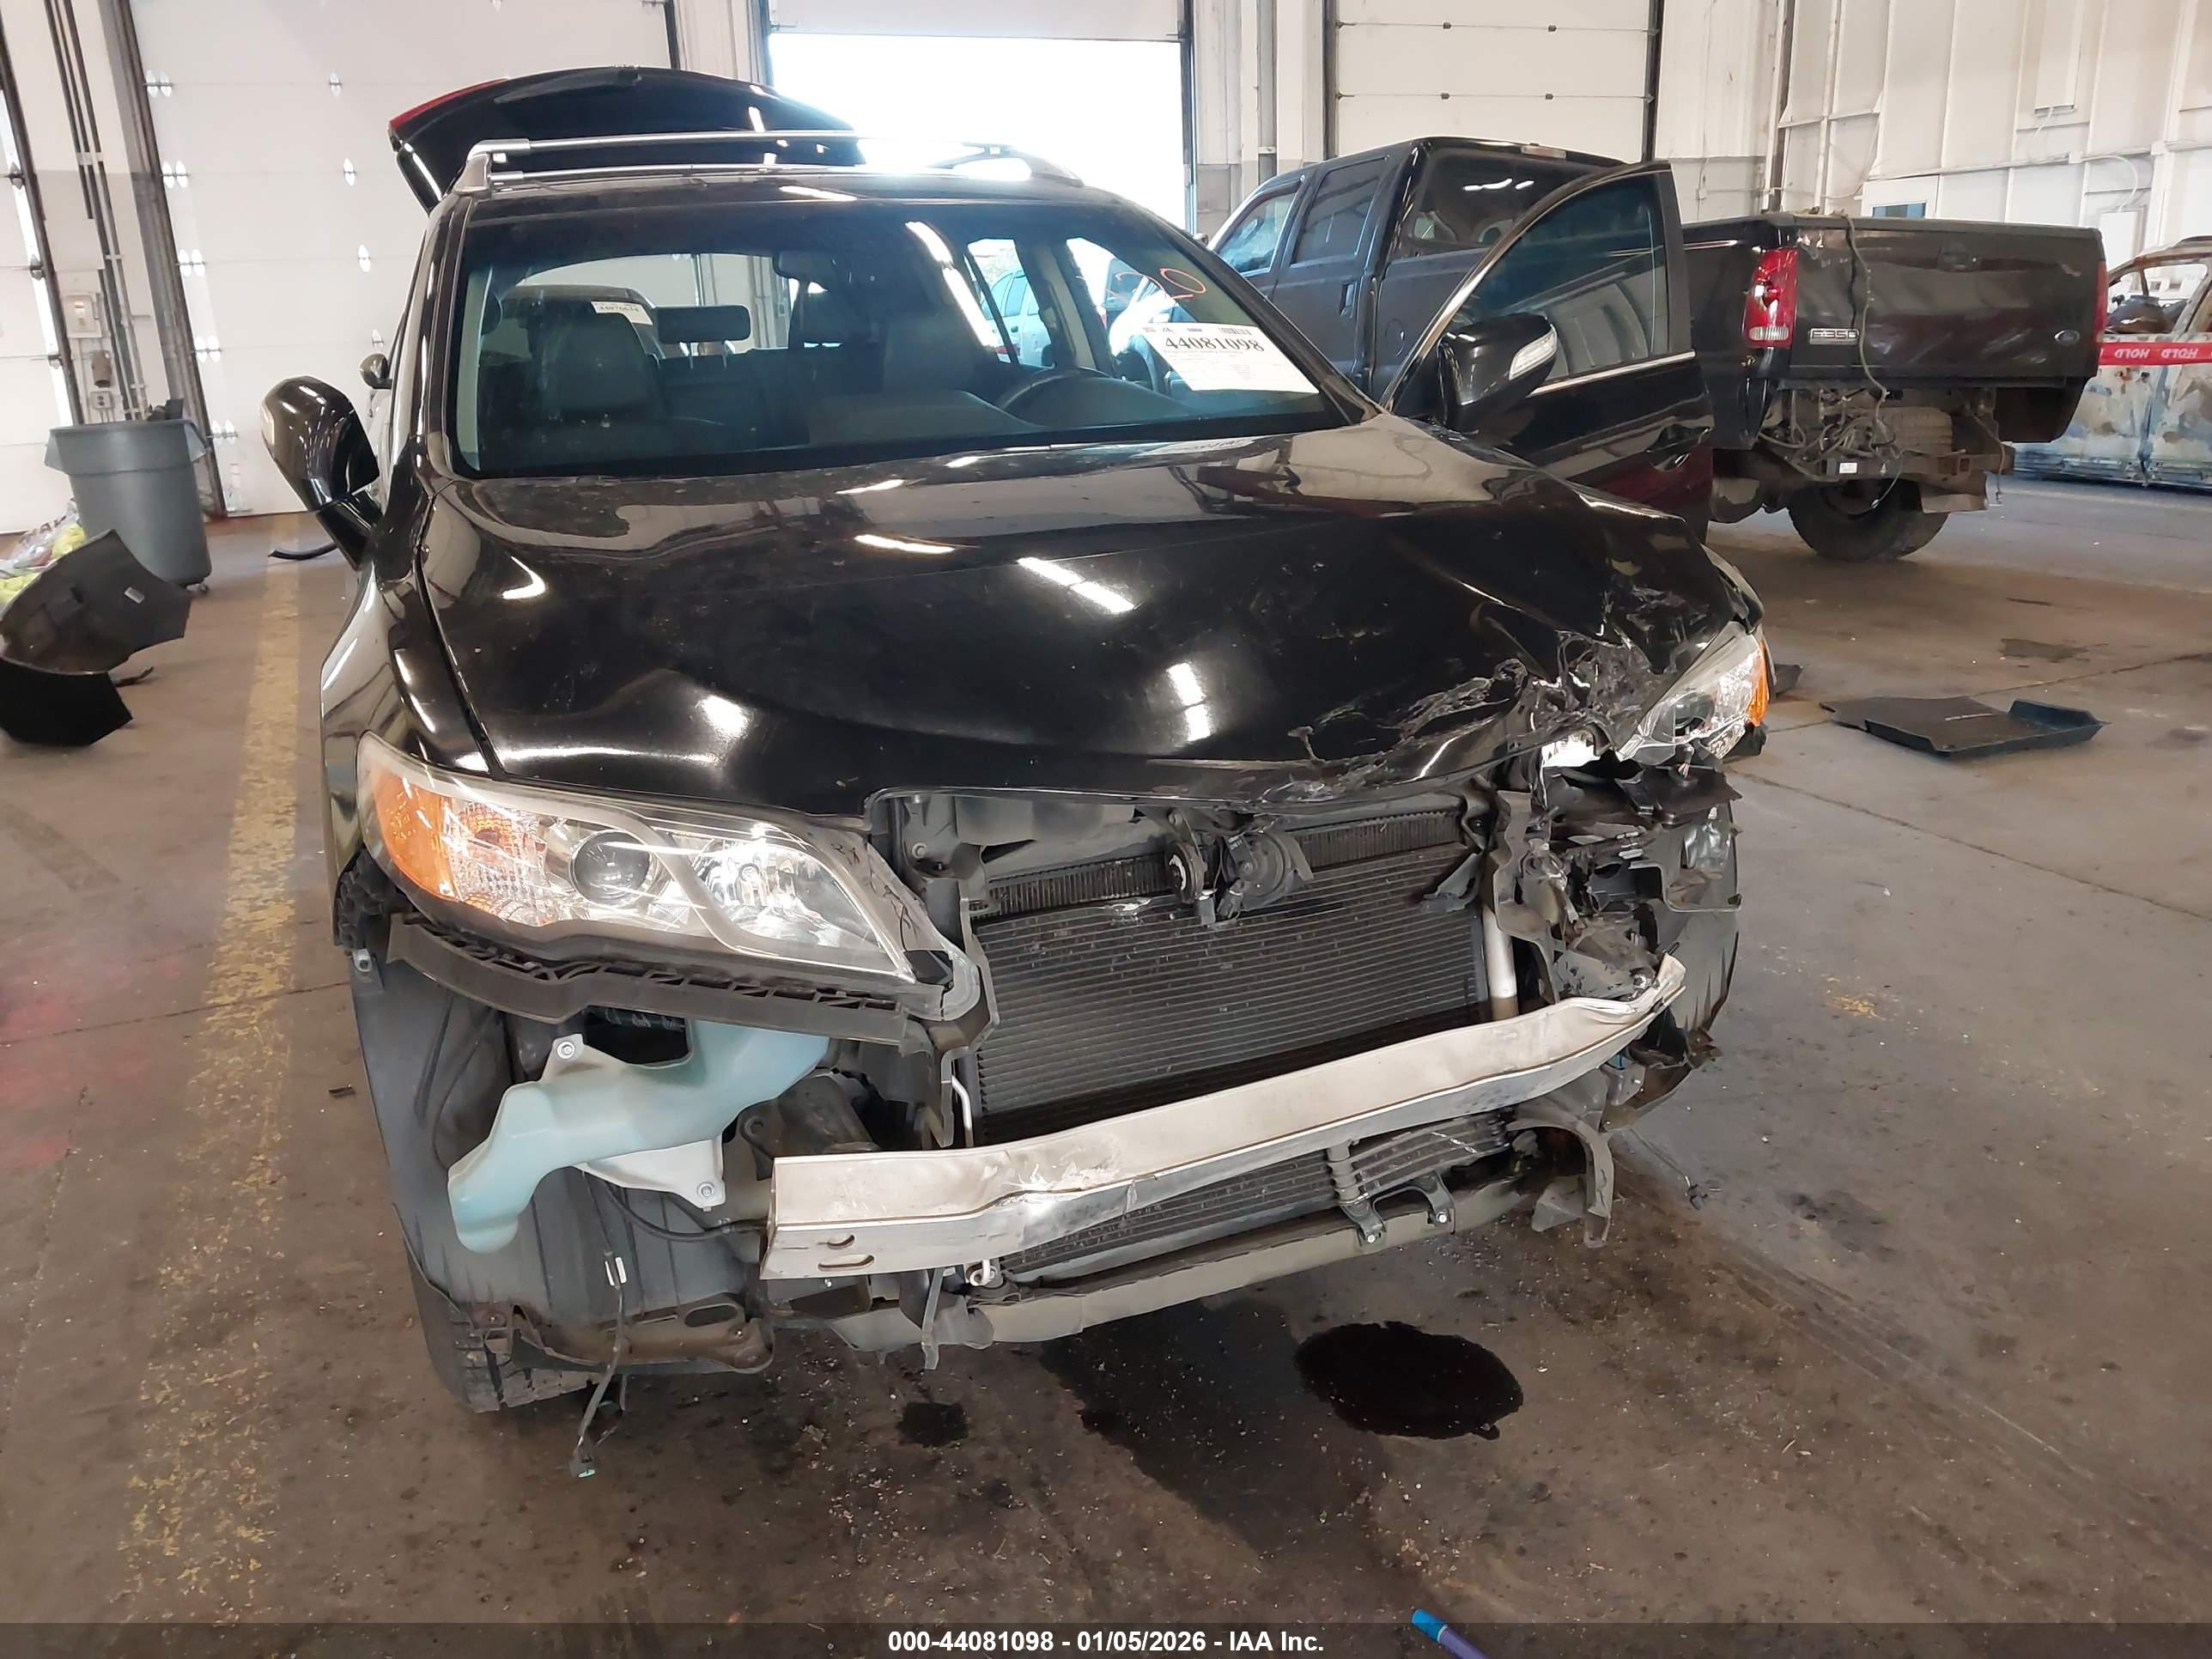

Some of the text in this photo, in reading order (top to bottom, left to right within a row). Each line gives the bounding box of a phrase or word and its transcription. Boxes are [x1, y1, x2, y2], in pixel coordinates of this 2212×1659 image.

[1165, 337, 1265, 352] 44081098
[2114, 348, 2150, 358] HOLD
[2160, 348, 2199, 358] HOLD
